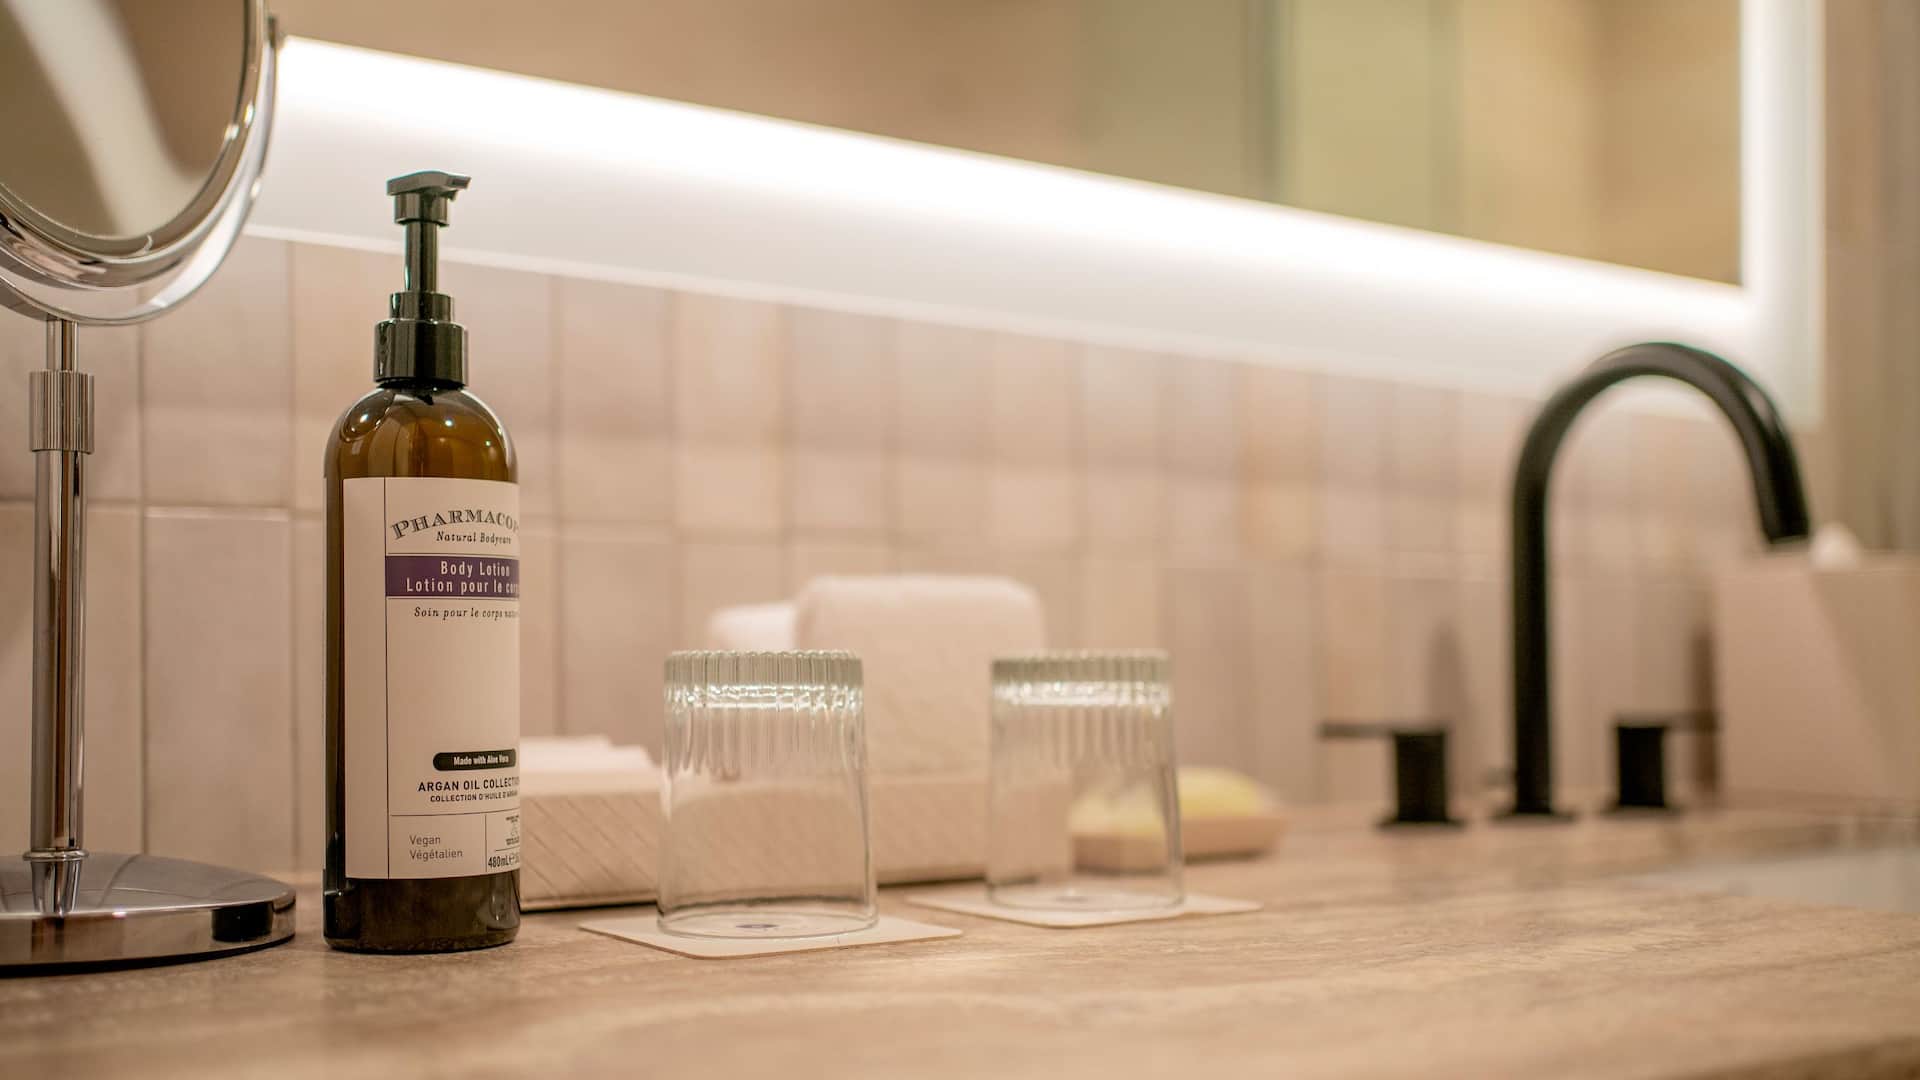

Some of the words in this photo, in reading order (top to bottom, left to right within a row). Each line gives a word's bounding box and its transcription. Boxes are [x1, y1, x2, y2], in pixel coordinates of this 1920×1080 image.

[436, 531, 477, 542] Natural
[441, 560, 473, 578] Body
[479, 561, 510, 577] Lotion
[406, 577, 453, 593] Lotion
[460, 581, 489, 595] pour
[493, 579, 502, 593] le
[414, 606, 439, 618] Soin
[442, 609, 468, 621] pour
[470, 607, 479, 618] le
[453, 756, 472, 766] Made
[473, 755, 486, 765] with
[418, 780, 459, 792] ARGAN
[463, 779, 480, 790] OIL
[430, 793, 477, 803] COLLECTION
[409, 834, 441, 847] Vegan
[409, 849, 463, 861] Végétalien
